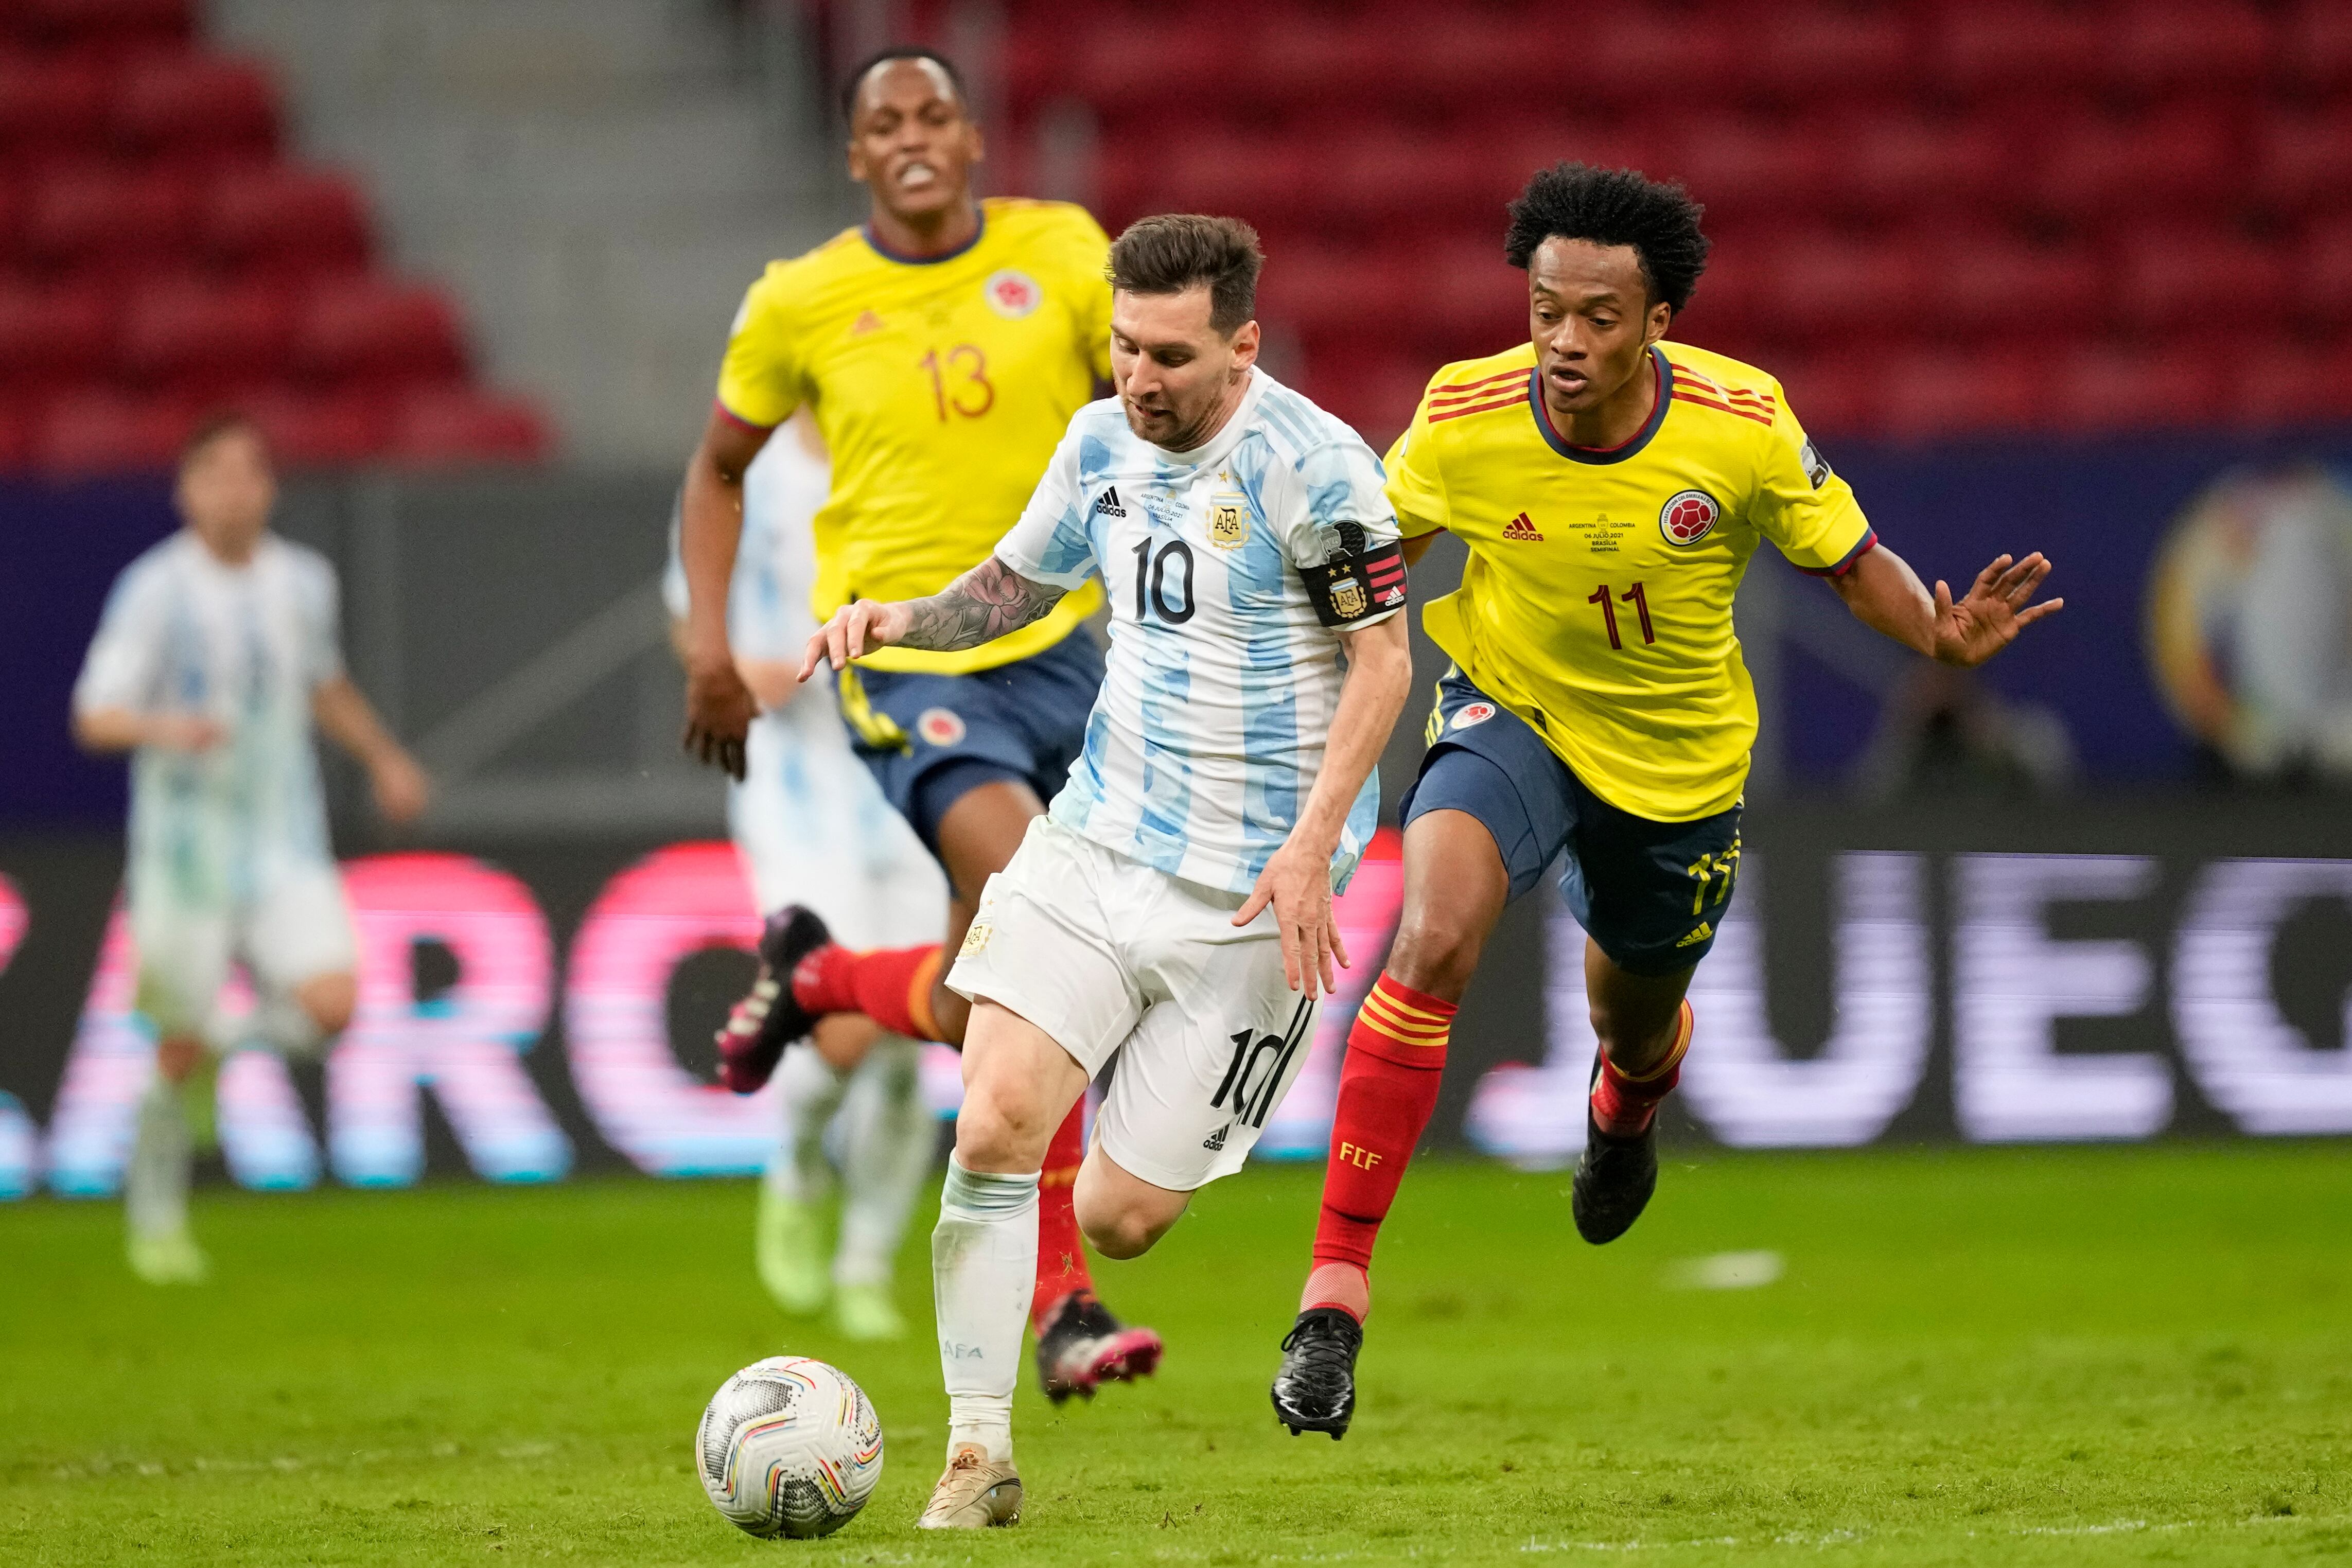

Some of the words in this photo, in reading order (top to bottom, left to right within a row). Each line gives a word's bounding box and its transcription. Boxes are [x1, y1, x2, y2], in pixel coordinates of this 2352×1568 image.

[920, 343, 995, 421] 13
[1140, 494, 1163, 502] ARGENTINA
[1096, 503, 1127, 518] adidas
[1215, 507, 1239, 535] AFA
[1503, 530, 1543, 541] adidas
[1131, 536, 1195, 625] 10
[1340, 589, 1358, 606] AFA
[1588, 582, 1655, 649] 11
[1339, 1141, 1382, 1171] FCF
[944, 1340, 984, 1359] AFA
